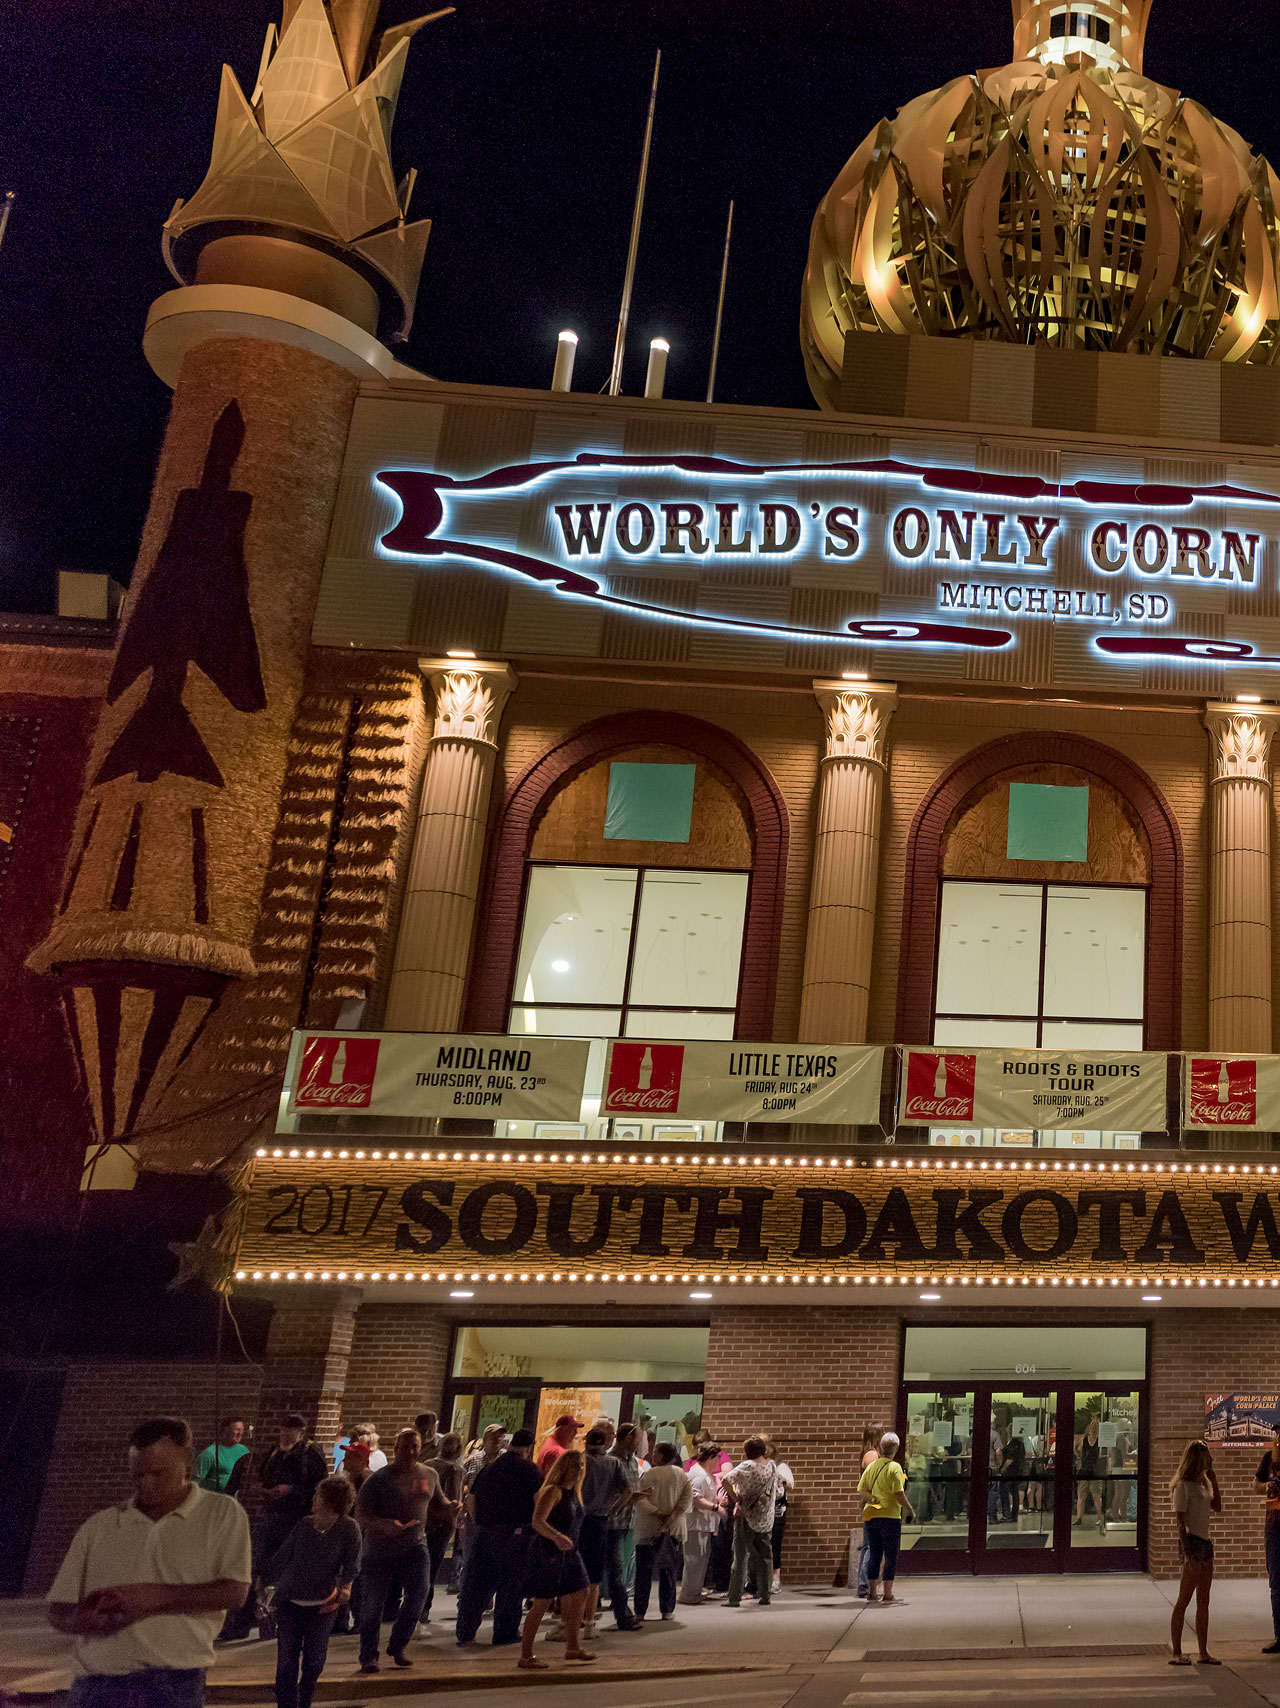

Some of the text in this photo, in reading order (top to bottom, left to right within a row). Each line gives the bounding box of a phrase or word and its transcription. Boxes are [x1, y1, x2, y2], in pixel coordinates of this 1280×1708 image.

[553, 501, 860, 557] WORLD'S
[892, 505, 1060, 568] ONLY
[1090, 519, 1260, 582] CORN
[939, 581, 1170, 621] MITCHELL, SD
[436, 1046, 531, 1072] MIDLAND
[729, 1052, 838, 1078] LITTLE TEXAS
[1003, 1061, 1140, 1077] ROOTS & BOOTS
[415, 1072, 484, 1090] THURSDAY,
[486, 1076, 517, 1090] AUG.
[745, 1081, 777, 1094] FRIDAY,
[780, 1082, 798, 1093] AUG
[1048, 1077, 1094, 1091] TOUR
[294, 1082, 372, 1107] Coca-Cola
[453, 1091, 503, 1106] 8:00PM
[606, 1087, 678, 1109] Coca-Cola
[1032, 1094, 1073, 1107] SATURDAY,
[1074, 1096, 1092, 1106] AUG.
[762, 1098, 796, 1110] 8:00PM
[906, 1095, 972, 1117] Coca-Cola
[1056, 1107, 1084, 1118] 7:00PM
[1191, 1101, 1255, 1121] Coca-Cola
[262, 1185, 388, 1238] 2017
[398, 1178, 775, 1262] SOUTH
[796, 1186, 1203, 1263] DAKOTA
[1015, 1364, 1036, 1374] 604
[1206, 1394, 1224, 1411] Free
